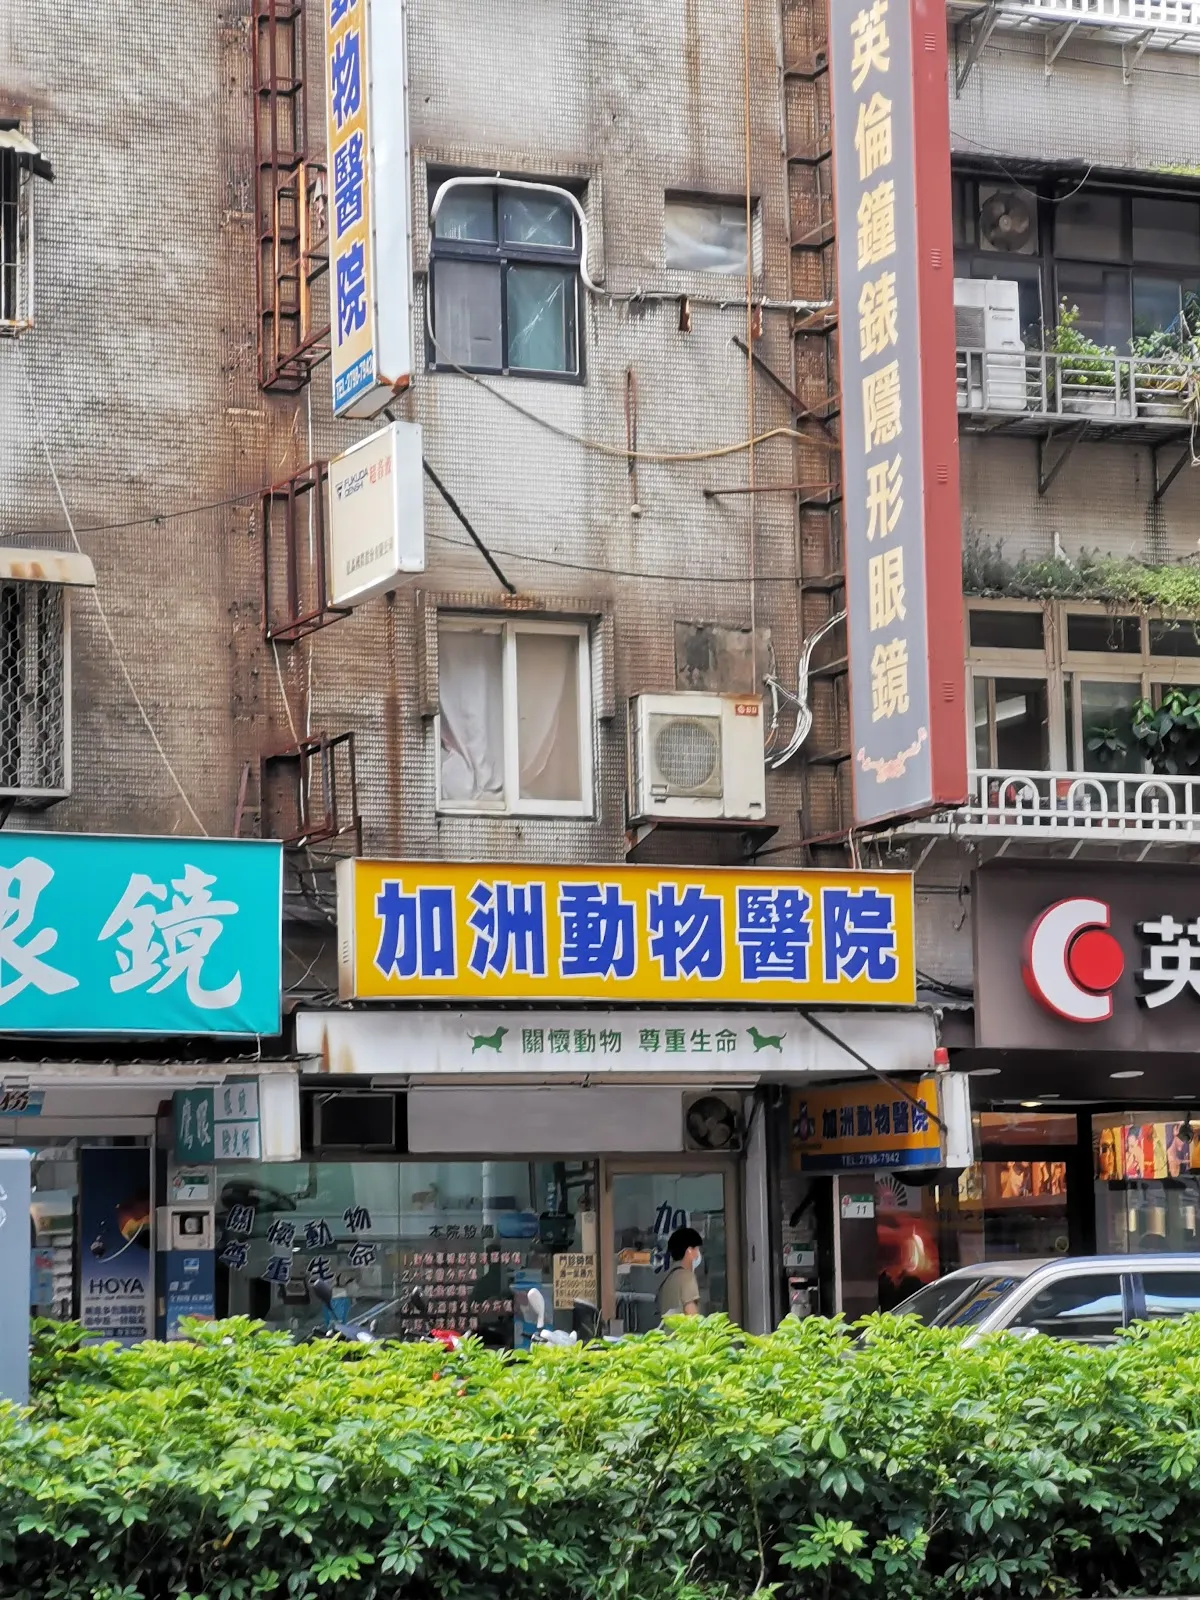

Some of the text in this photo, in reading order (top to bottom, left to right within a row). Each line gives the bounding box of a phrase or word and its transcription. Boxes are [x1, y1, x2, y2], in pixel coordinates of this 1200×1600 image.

[849, 0, 912, 724] 英倫鐘錶隱形眼鏡
[374, 879, 901, 985] 加洲動物醫院
[521, 1028, 738, 1054] 關懷動物 尊重生命
[822, 1099, 928, 1140] 加洲動物醫院
[856, 1205, 867, 1215] 11
[89, 1278, 145, 1294] HOYA
